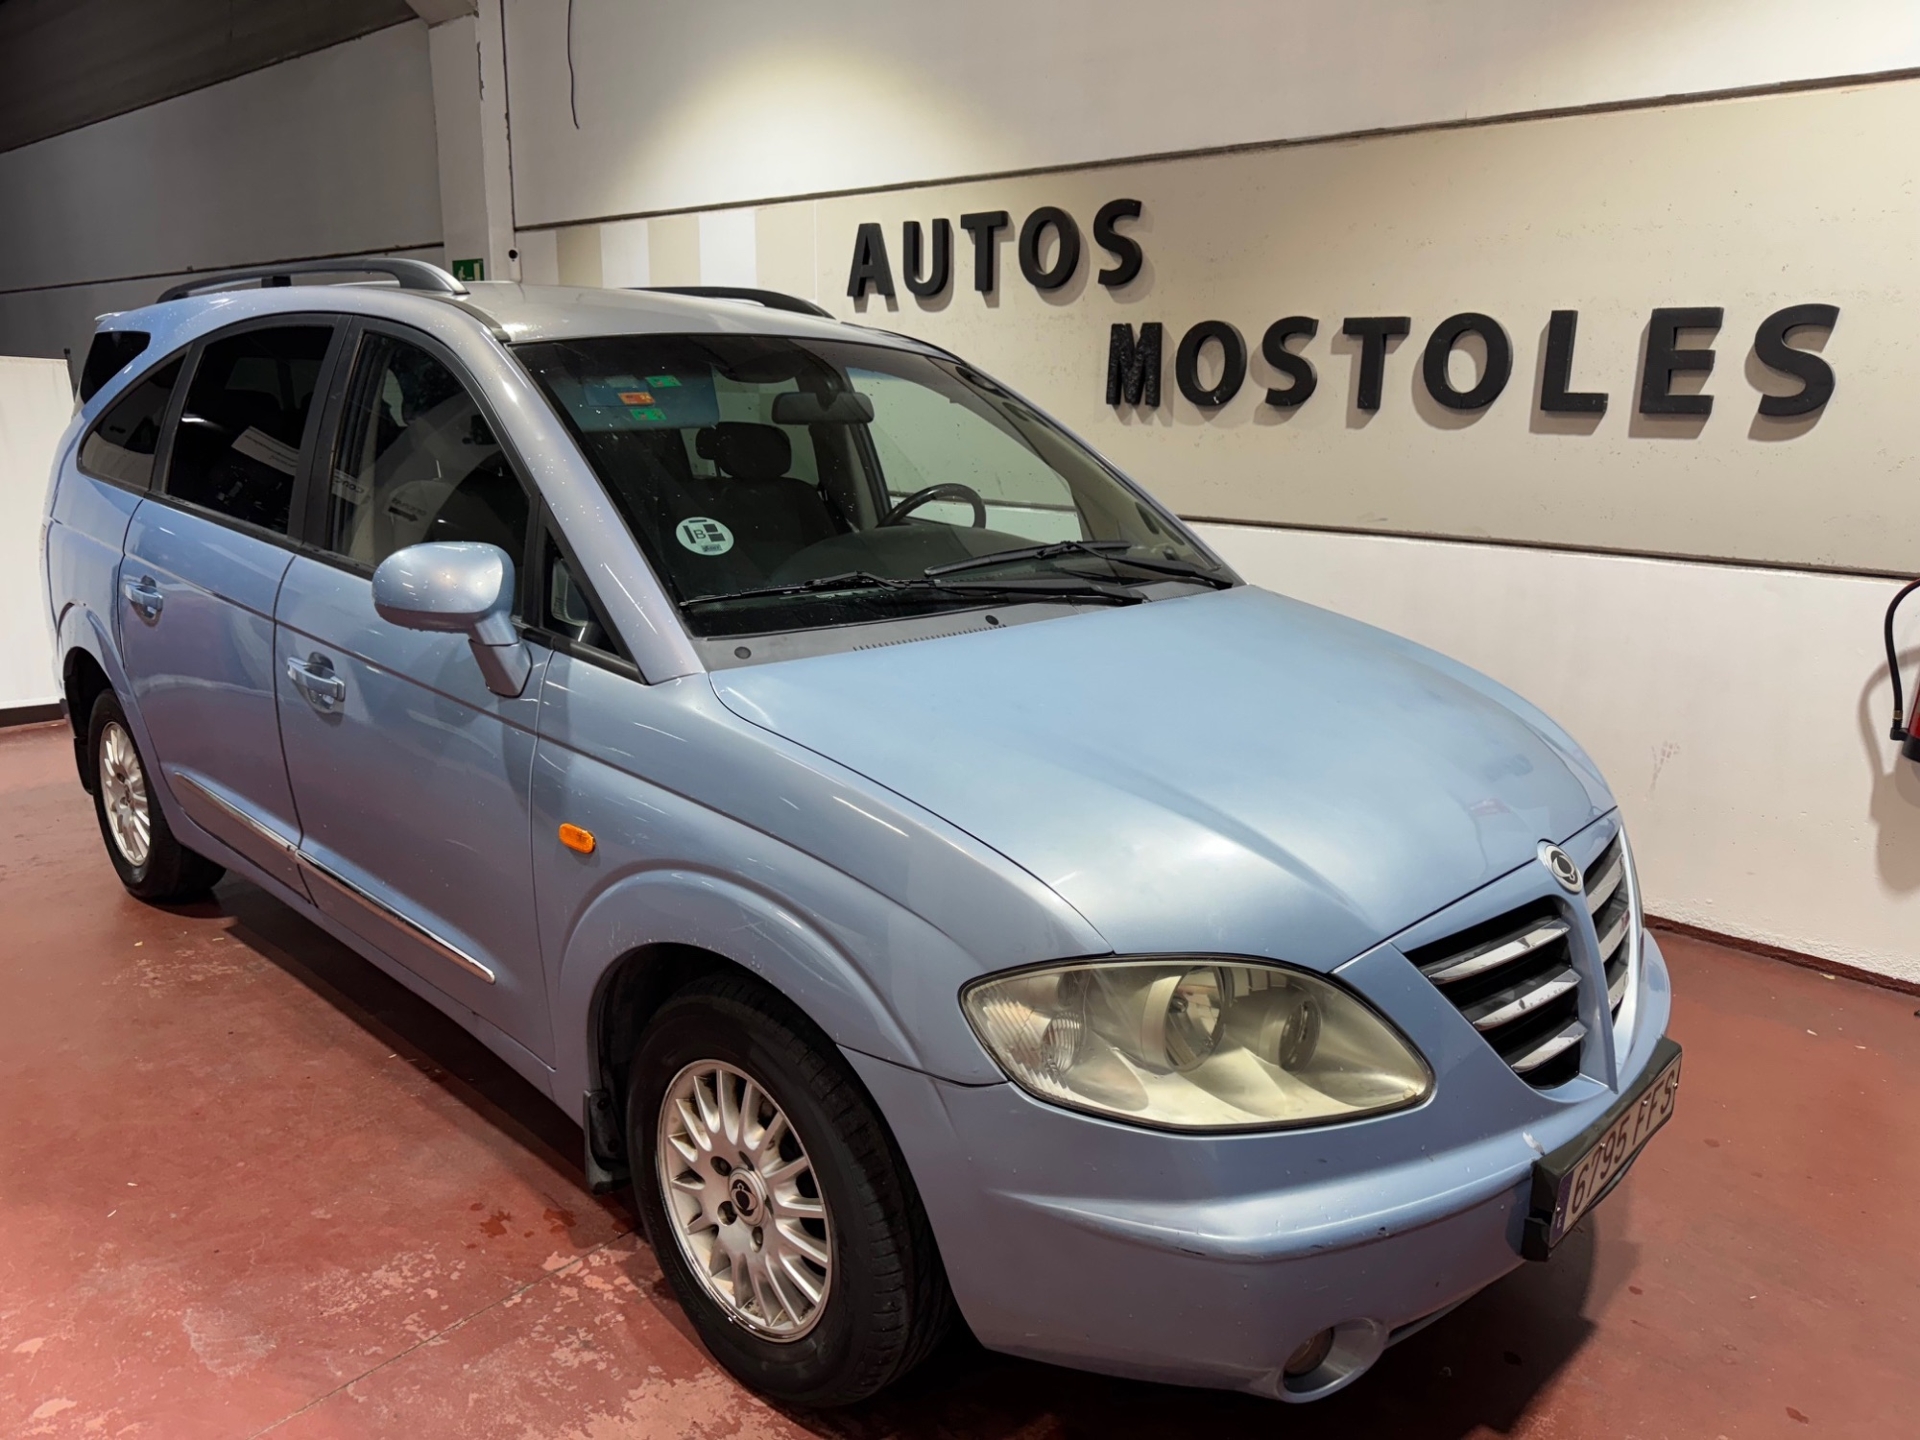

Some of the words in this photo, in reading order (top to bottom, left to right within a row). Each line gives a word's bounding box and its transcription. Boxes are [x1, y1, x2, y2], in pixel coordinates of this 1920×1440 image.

[847, 198, 1142, 296] AUTOS
[1106, 304, 1840, 417] MOSTOLES
[1571, 1113, 1630, 1215] 6795
[1633, 1069, 1675, 1146] FFS
